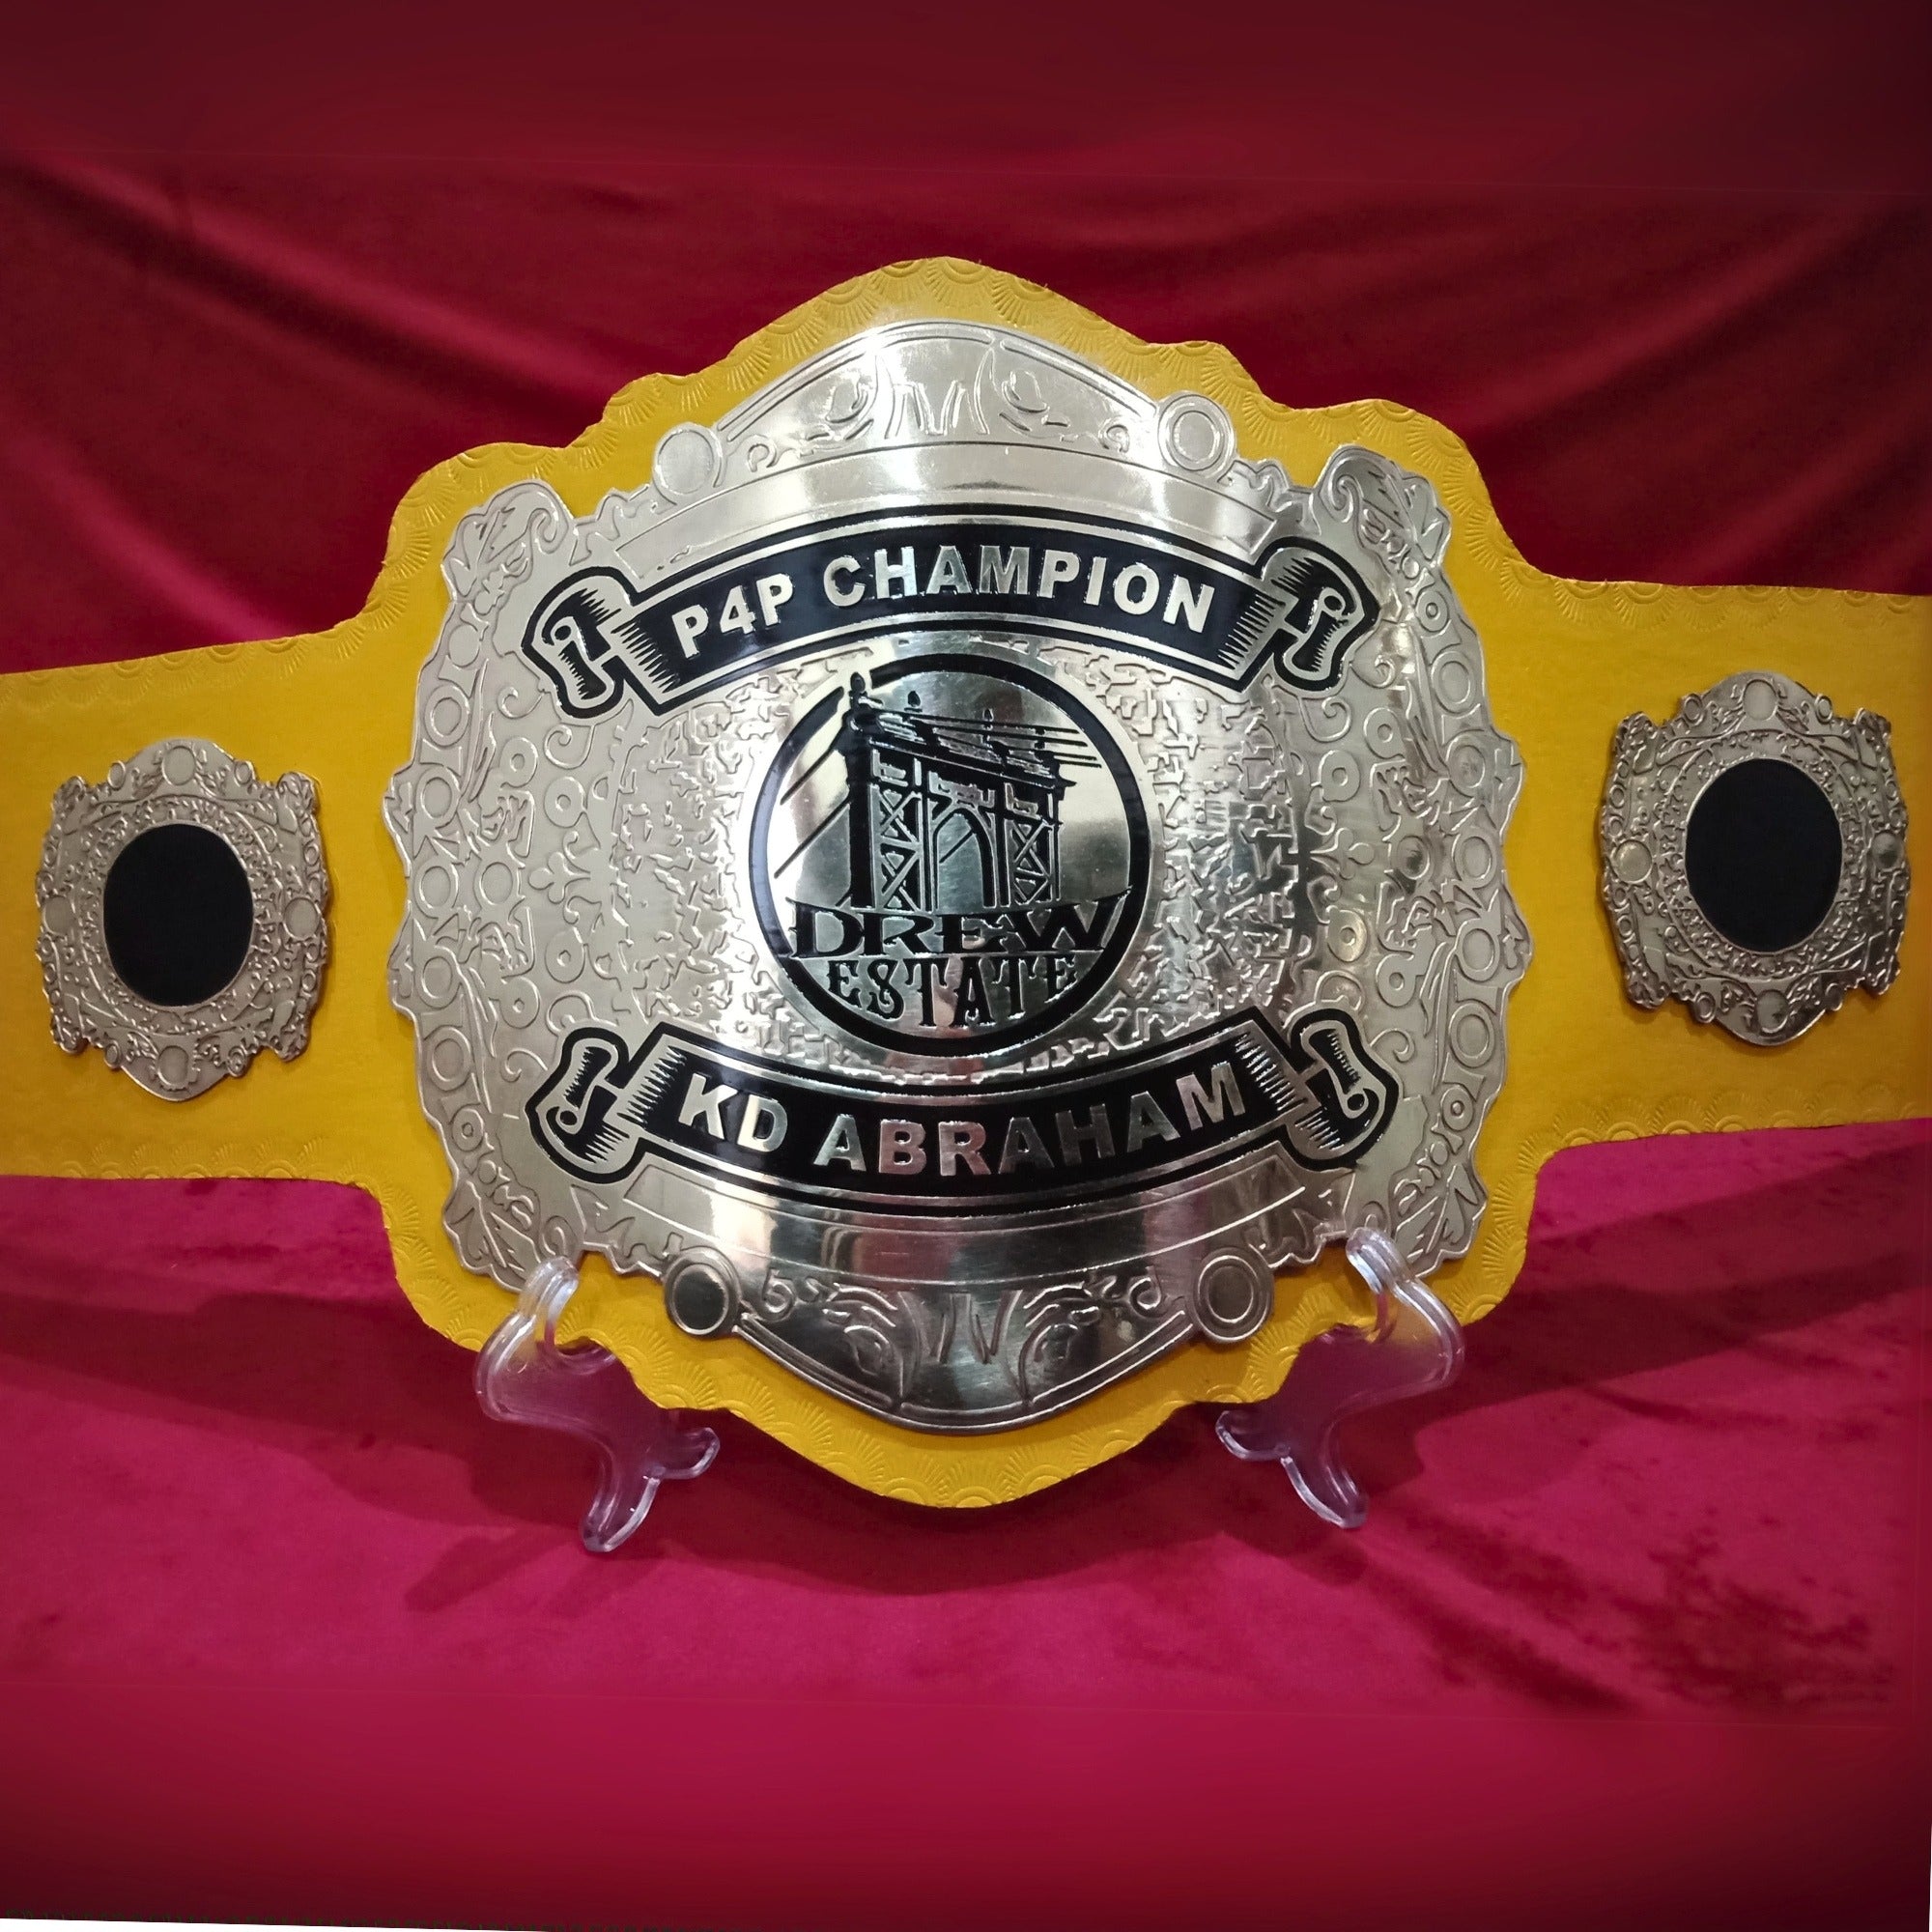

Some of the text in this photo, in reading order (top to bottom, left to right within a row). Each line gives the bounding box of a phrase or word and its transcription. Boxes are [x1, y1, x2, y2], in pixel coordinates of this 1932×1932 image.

[672, 545, 1214, 658] P4P CHAMPION
[786, 886, 1131, 958] DREW
[826, 955, 1076, 1028] ESTATE
[677, 1062, 1246, 1176] KD ABRAHAM
